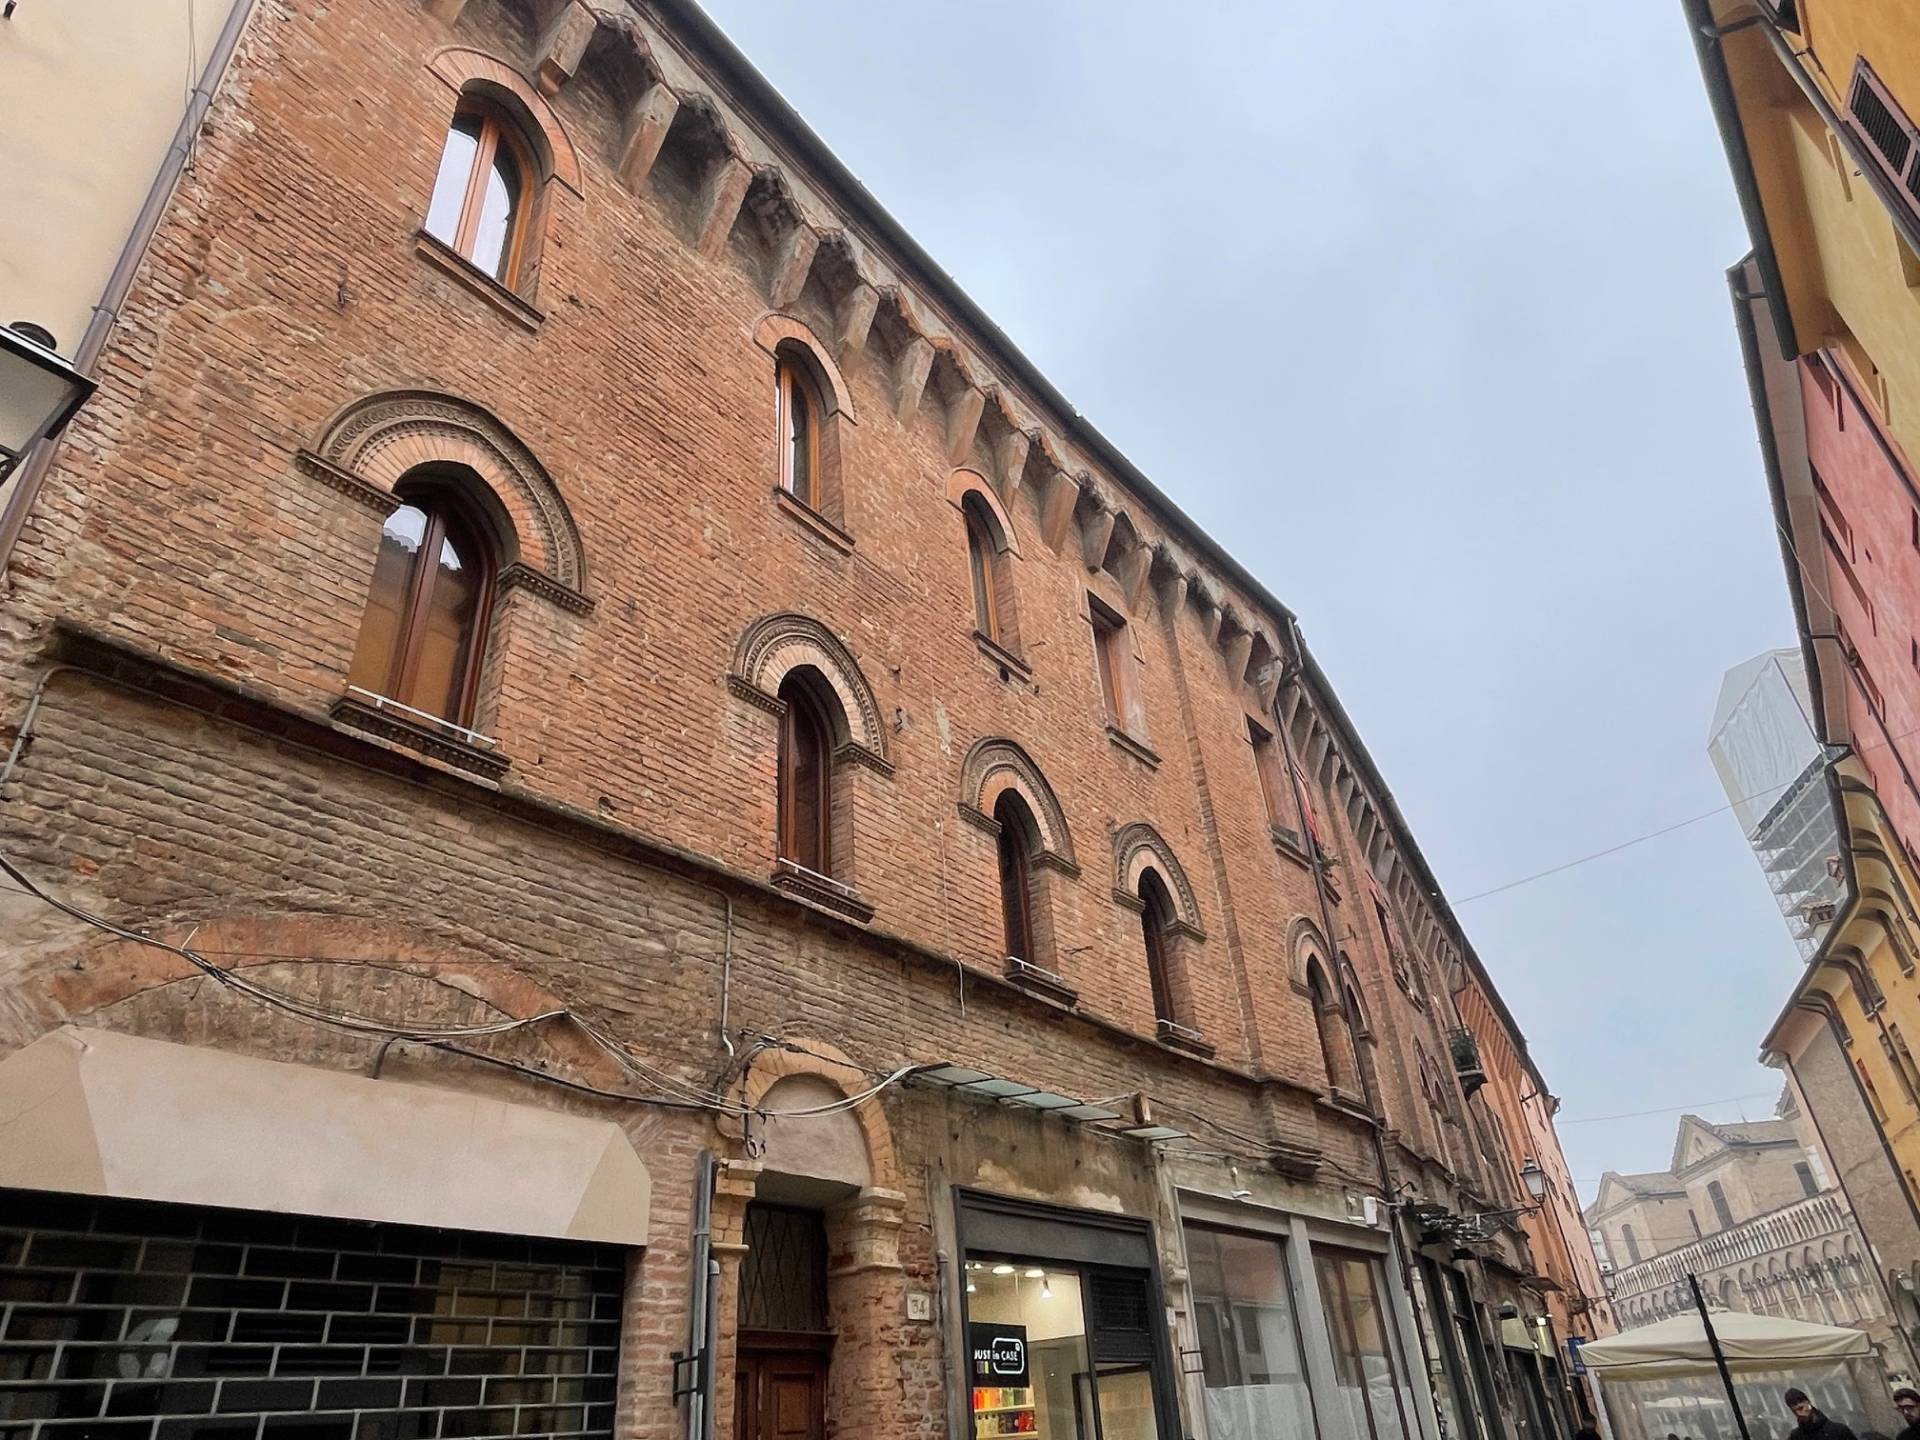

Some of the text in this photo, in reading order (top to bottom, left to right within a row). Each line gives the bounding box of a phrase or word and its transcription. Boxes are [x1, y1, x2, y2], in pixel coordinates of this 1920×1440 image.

[911, 1299, 926, 1314] 34
[974, 1349, 1018, 1361] JUST in CASE
